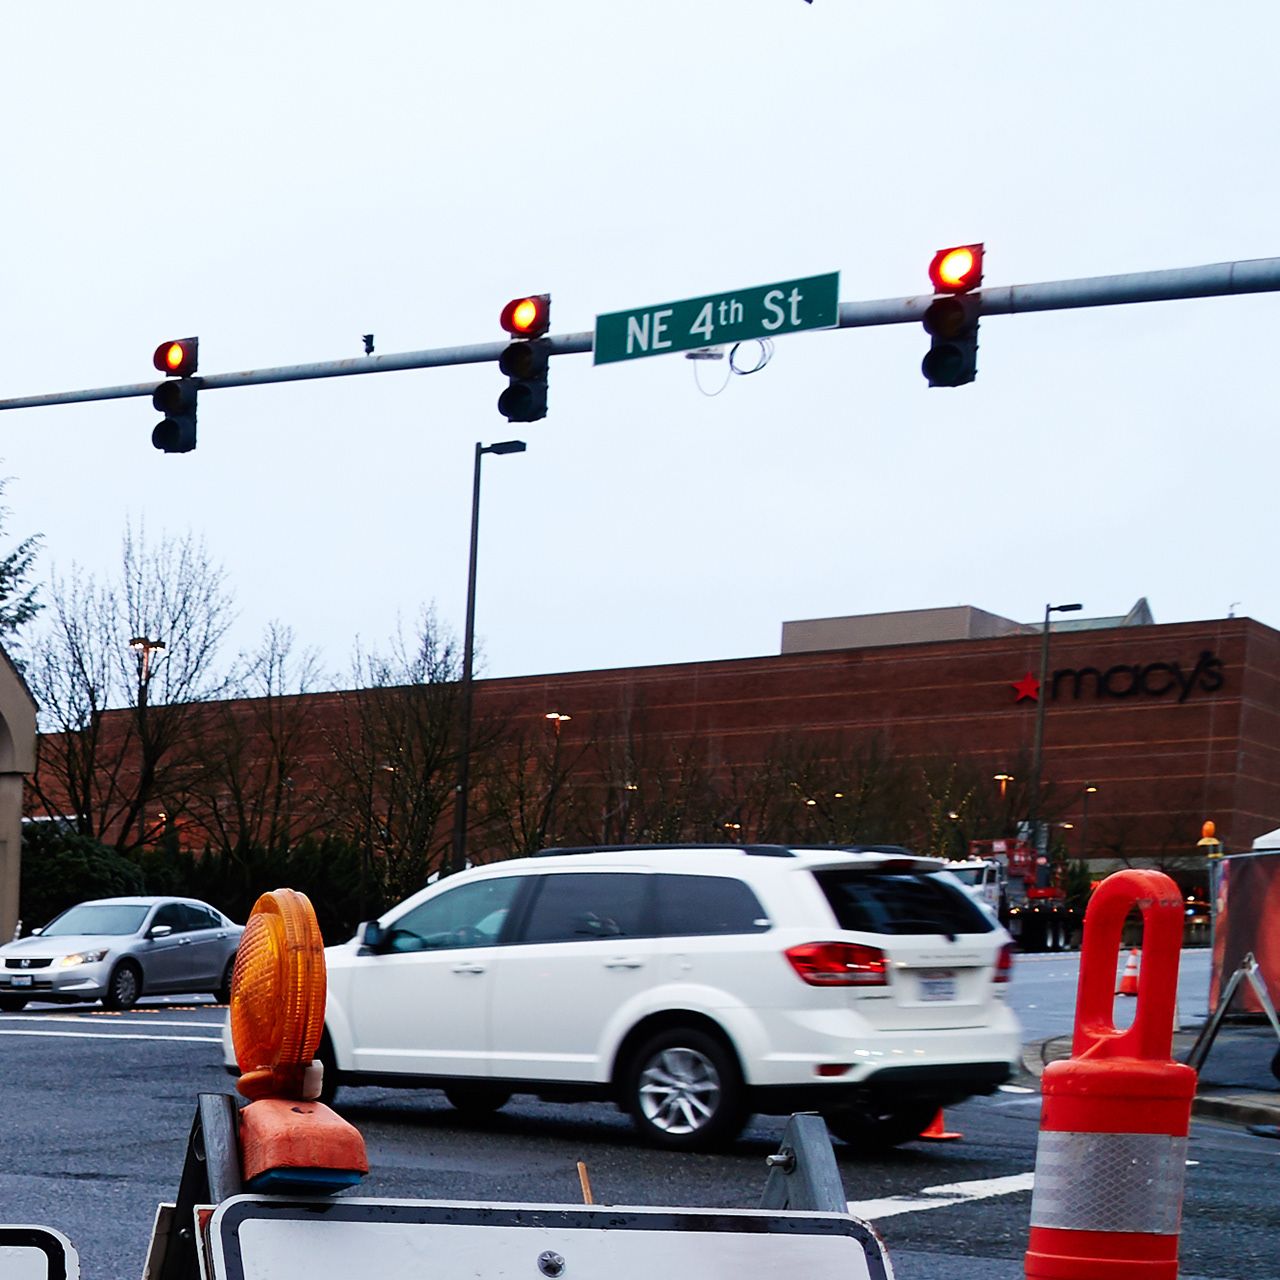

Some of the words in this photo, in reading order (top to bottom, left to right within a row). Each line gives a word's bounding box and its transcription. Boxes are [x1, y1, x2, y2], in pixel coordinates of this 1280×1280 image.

[626, 309, 673, 354] NE
[690, 298, 743, 341] 4th
[762, 287, 804, 330] St
[1052, 651, 1224, 704] macy's
